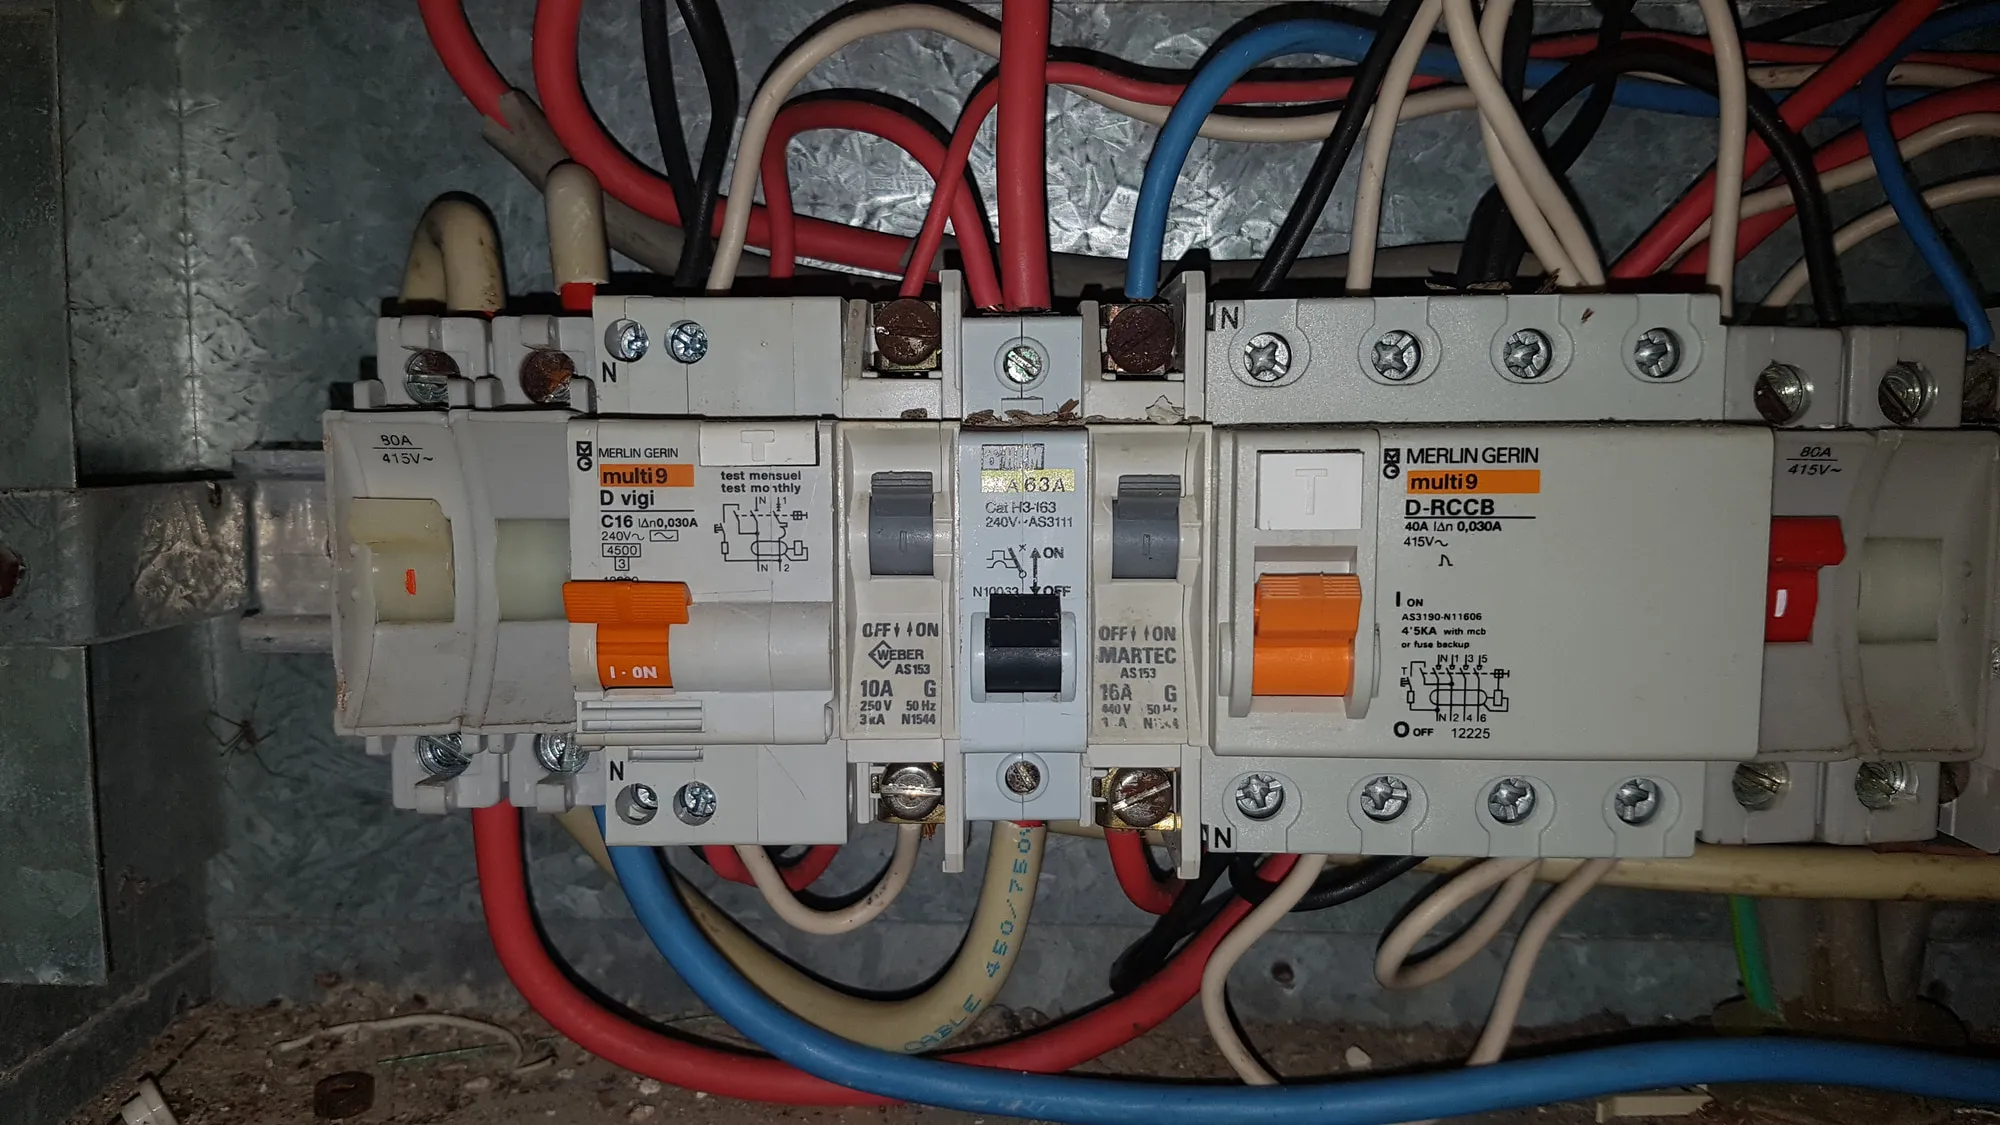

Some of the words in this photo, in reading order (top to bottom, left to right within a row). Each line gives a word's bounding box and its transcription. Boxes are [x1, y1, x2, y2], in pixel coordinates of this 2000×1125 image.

[1221, 306, 1239, 329] N
[601, 361, 617, 383] N
[380, 434, 413, 446] 80A
[598, 447, 641, 458] MERLIN
[644, 447, 679, 458] GERIN
[1406, 447, 1478, 464] MERLIN
[1482, 447, 1539, 463] GERIN
[1800, 446, 1831, 457] 80A
[720, 470, 745, 480] test
[749, 470, 801, 480] mensuel
[720, 483, 745, 493] test
[751, 483, 801, 494] monthly
[600, 489, 614, 506] D
[621, 489, 655, 509] vigi
[1405, 498, 1495, 516] D-RCCB
[601, 514, 634, 528] C16
[1404, 521, 1428, 532] 40A
[1456, 521, 1502, 533] 0,030A
[607, 545, 638, 556] 4500
[1043, 547, 1064, 559] ON
[618, 558, 626, 569] 3
[1043, 585, 1071, 597] OFF
[1406, 598, 1424, 607] ON
[1401, 613, 1482, 621] AS3190-N11606
[862, 622, 891, 638] OFF
[916, 622, 939, 637] ON
[1098, 626, 1128, 641] OFF
[1152, 626, 1176, 641] ON
[1443, 627, 1464, 635] with
[1467, 627, 1486, 635] mcb
[1414, 640, 1433, 648] fuse
[1436, 640, 1470, 649] backup
[877, 649, 924, 660] WEBER
[1098, 647, 1177, 664] MARTEC
[1467, 654, 1474, 662] 3
[1481, 654, 1488, 662] 5
[632, 665, 658, 679] ON
[895, 663, 930, 675] AS153
[1120, 667, 1157, 679] AS153
[860, 680, 893, 697] 10A
[924, 680, 937, 697] G
[1100, 683, 1132, 701] 16A
[1164, 684, 1177, 702] G
[860, 700, 882, 711] 250
[884, 700, 892, 711] V
[906, 700, 919, 711] 50
[921, 700, 936, 711] Hz
[1146, 704, 1160, 714] 50
[901, 713, 936, 725] N1544
[1453, 713, 1459, 721] 2
[1466, 713, 1473, 721] 4
[1480, 713, 1487, 721] 6
[1413, 728, 1434, 737] OFF
[1451, 728, 1491, 739] 12225
[609, 760, 624, 781] N
[1214, 827, 1232, 848] N
[904, 993, 982, 1052] CABLE
